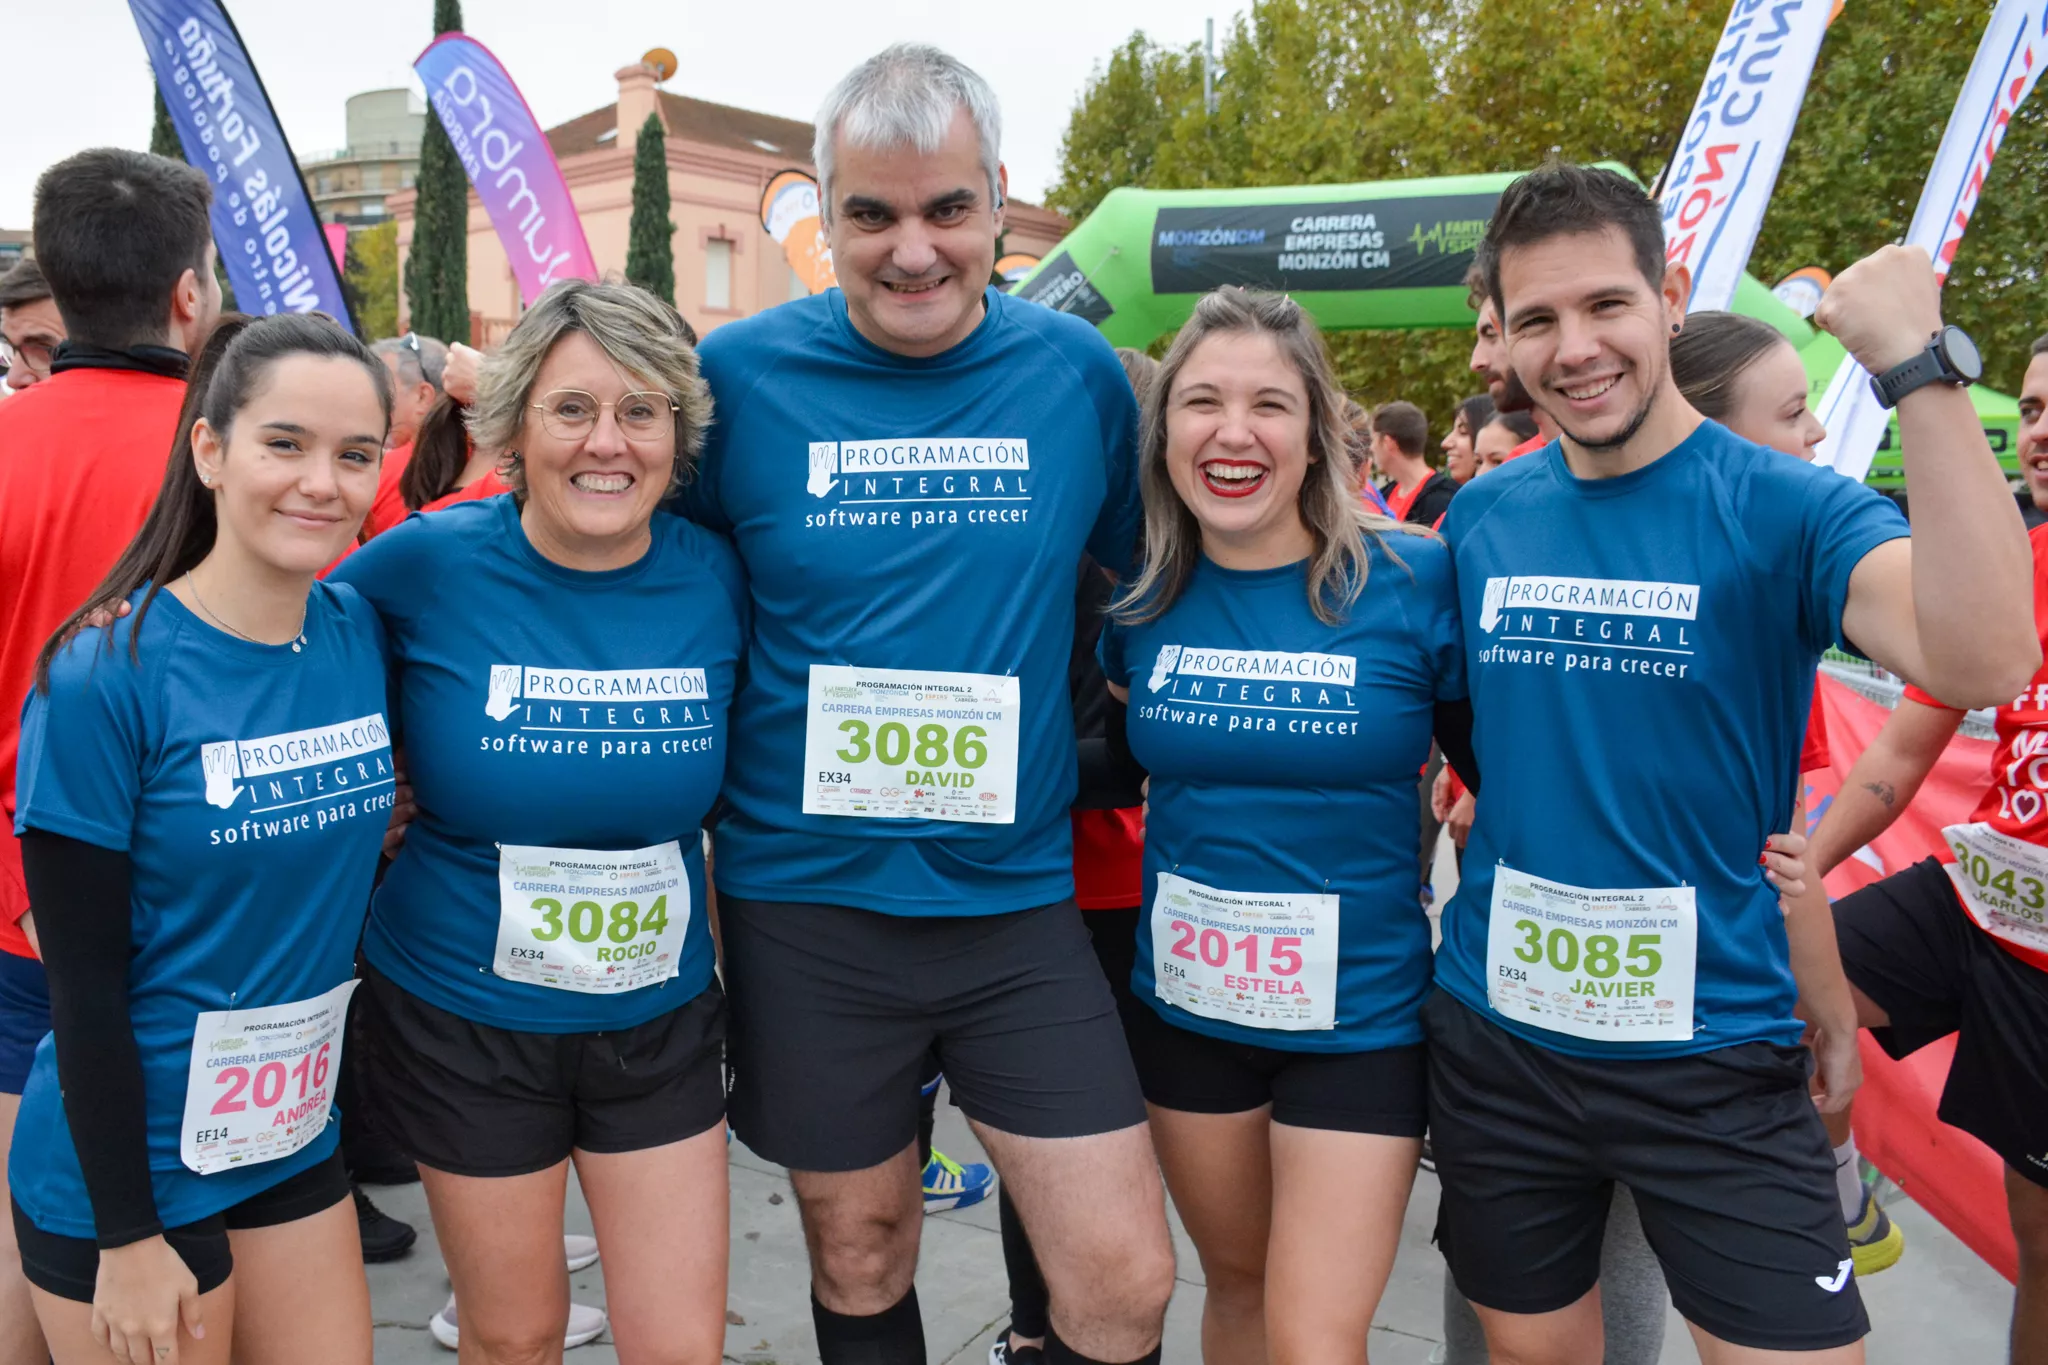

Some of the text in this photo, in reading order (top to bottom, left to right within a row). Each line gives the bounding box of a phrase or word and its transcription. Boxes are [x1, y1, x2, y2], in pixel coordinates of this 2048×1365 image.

[1290, 213, 1377, 234] CARRERA
[1158, 224, 1267, 248] MONZÓNCM
[1284, 230, 1385, 252] EMPRESAS
[1278, 249, 1391, 271] MONZÓN CM
[845, 441, 1025, 467] PROGRAMACIÓN
[844, 475, 1027, 496] INTEGRAL
[805, 507, 1029, 529] software para crecer
[1510, 582, 1693, 613] PROGRAMACIÓN
[1504, 614, 1690, 646] INTEGRAL
[1182, 652, 1352, 681] PROGRAMACIÓN
[1478, 644, 1689, 679] software para crecer
[529, 671, 705, 696] PROGRAMACIÓN
[855, 680, 923, 692] PROGRAMACIÓN
[924, 684, 965, 693] INTEGRAL
[1171, 678, 1356, 708] INTEGRAL
[526, 704, 711, 725] INTEGRAL
[821, 702, 1002, 721] CARRERA EMPRESAS MONZÓN CM
[1139, 703, 1359, 736] software para crecer
[241, 718, 388, 770] PROGRAMACIÓN
[479, 733, 714, 759] software para crecer
[836, 719, 988, 770] 3086
[818, 770, 852, 785] EX34
[905, 770, 975, 788] DAVID
[209, 812, 311, 846] software
[316, 802, 357, 830] para
[549, 860, 618, 871] PROGRAMACIÓN
[619, 860, 653, 871] INTEGRAL
[513, 878, 679, 897] CARRERA EMPRESAS MONZÓN CM
[1188, 888, 1243, 906] PROGRAMACIÓN
[1245, 900, 1285, 908] INTEGRAL
[1529, 881, 1590, 901] PROGRAMACIÓN
[1591, 894, 1637, 903] INTEGRAL
[530, 894, 670, 944] 3084
[1163, 906, 1315, 936] CARRERA EMPRESAS MONZÓN CM
[1501, 899, 1679, 930] CARRERA EMPRESAS MONZÓN CM
[510, 947, 545, 961] EX34
[596, 940, 657, 963] ROCIO
[1170, 919, 1303, 977] 2015
[1513, 918, 1663, 979] 3085
[1163, 962, 1186, 979] EF14
[1498, 965, 1528, 983] EX34
[1224, 974, 1305, 995] ESTELA
[1569, 979, 1656, 998] JAVIER
[243, 1017, 306, 1033] PROGRAMACIÓN
[307, 1008, 330, 1024] INTEGRAL
[206, 1052, 256, 1069] CARRERA
[258, 1043, 309, 1063] EMPRESAS
[209, 1042, 330, 1116] 2016
[272, 1087, 327, 1128] ANDREA
[195, 1127, 229, 1144] EF14
